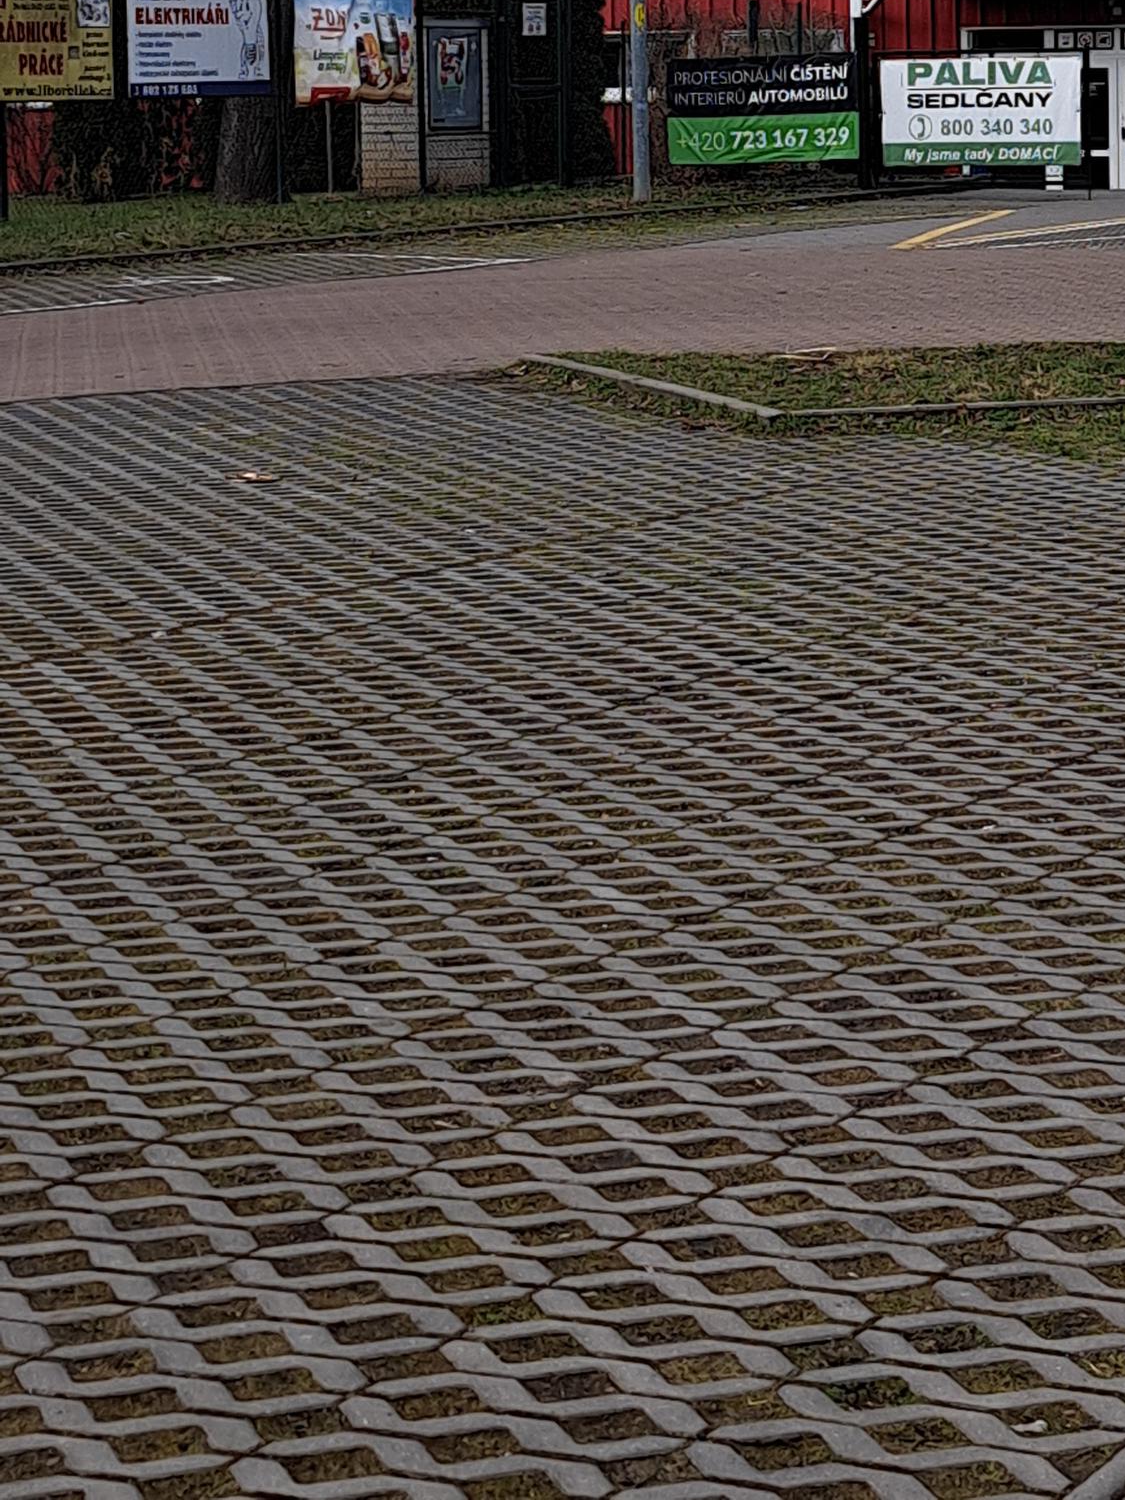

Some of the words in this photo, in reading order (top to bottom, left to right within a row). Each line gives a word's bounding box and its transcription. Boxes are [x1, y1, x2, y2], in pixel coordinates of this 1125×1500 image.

[135, 2, 230, 25] ELEKTRIKÁŘI
[18, 48, 64, 76] PRÁCE
[907, 61, 1053, 86] PALIVA
[674, 66, 788, 86] PROFESIONÁLNÍ
[790, 62, 848, 82] ČIŠTĚNÍ
[748, 83, 848, 106] AUTOMOBILŮ
[940, 118, 974, 135] 800
[980, 118, 1013, 135] 340
[1019, 118, 1053, 135] 340
[676, 131, 726, 152] +420
[729, 130, 767, 149] 723
[772, 128, 808, 148] 167
[813, 126, 850, 147] 329
[903, 148, 923, 163] My
[926, 148, 960, 163] jsme
[964, 147, 996, 162] tady
[998, 144, 1062, 161] DOMÁCÍ
